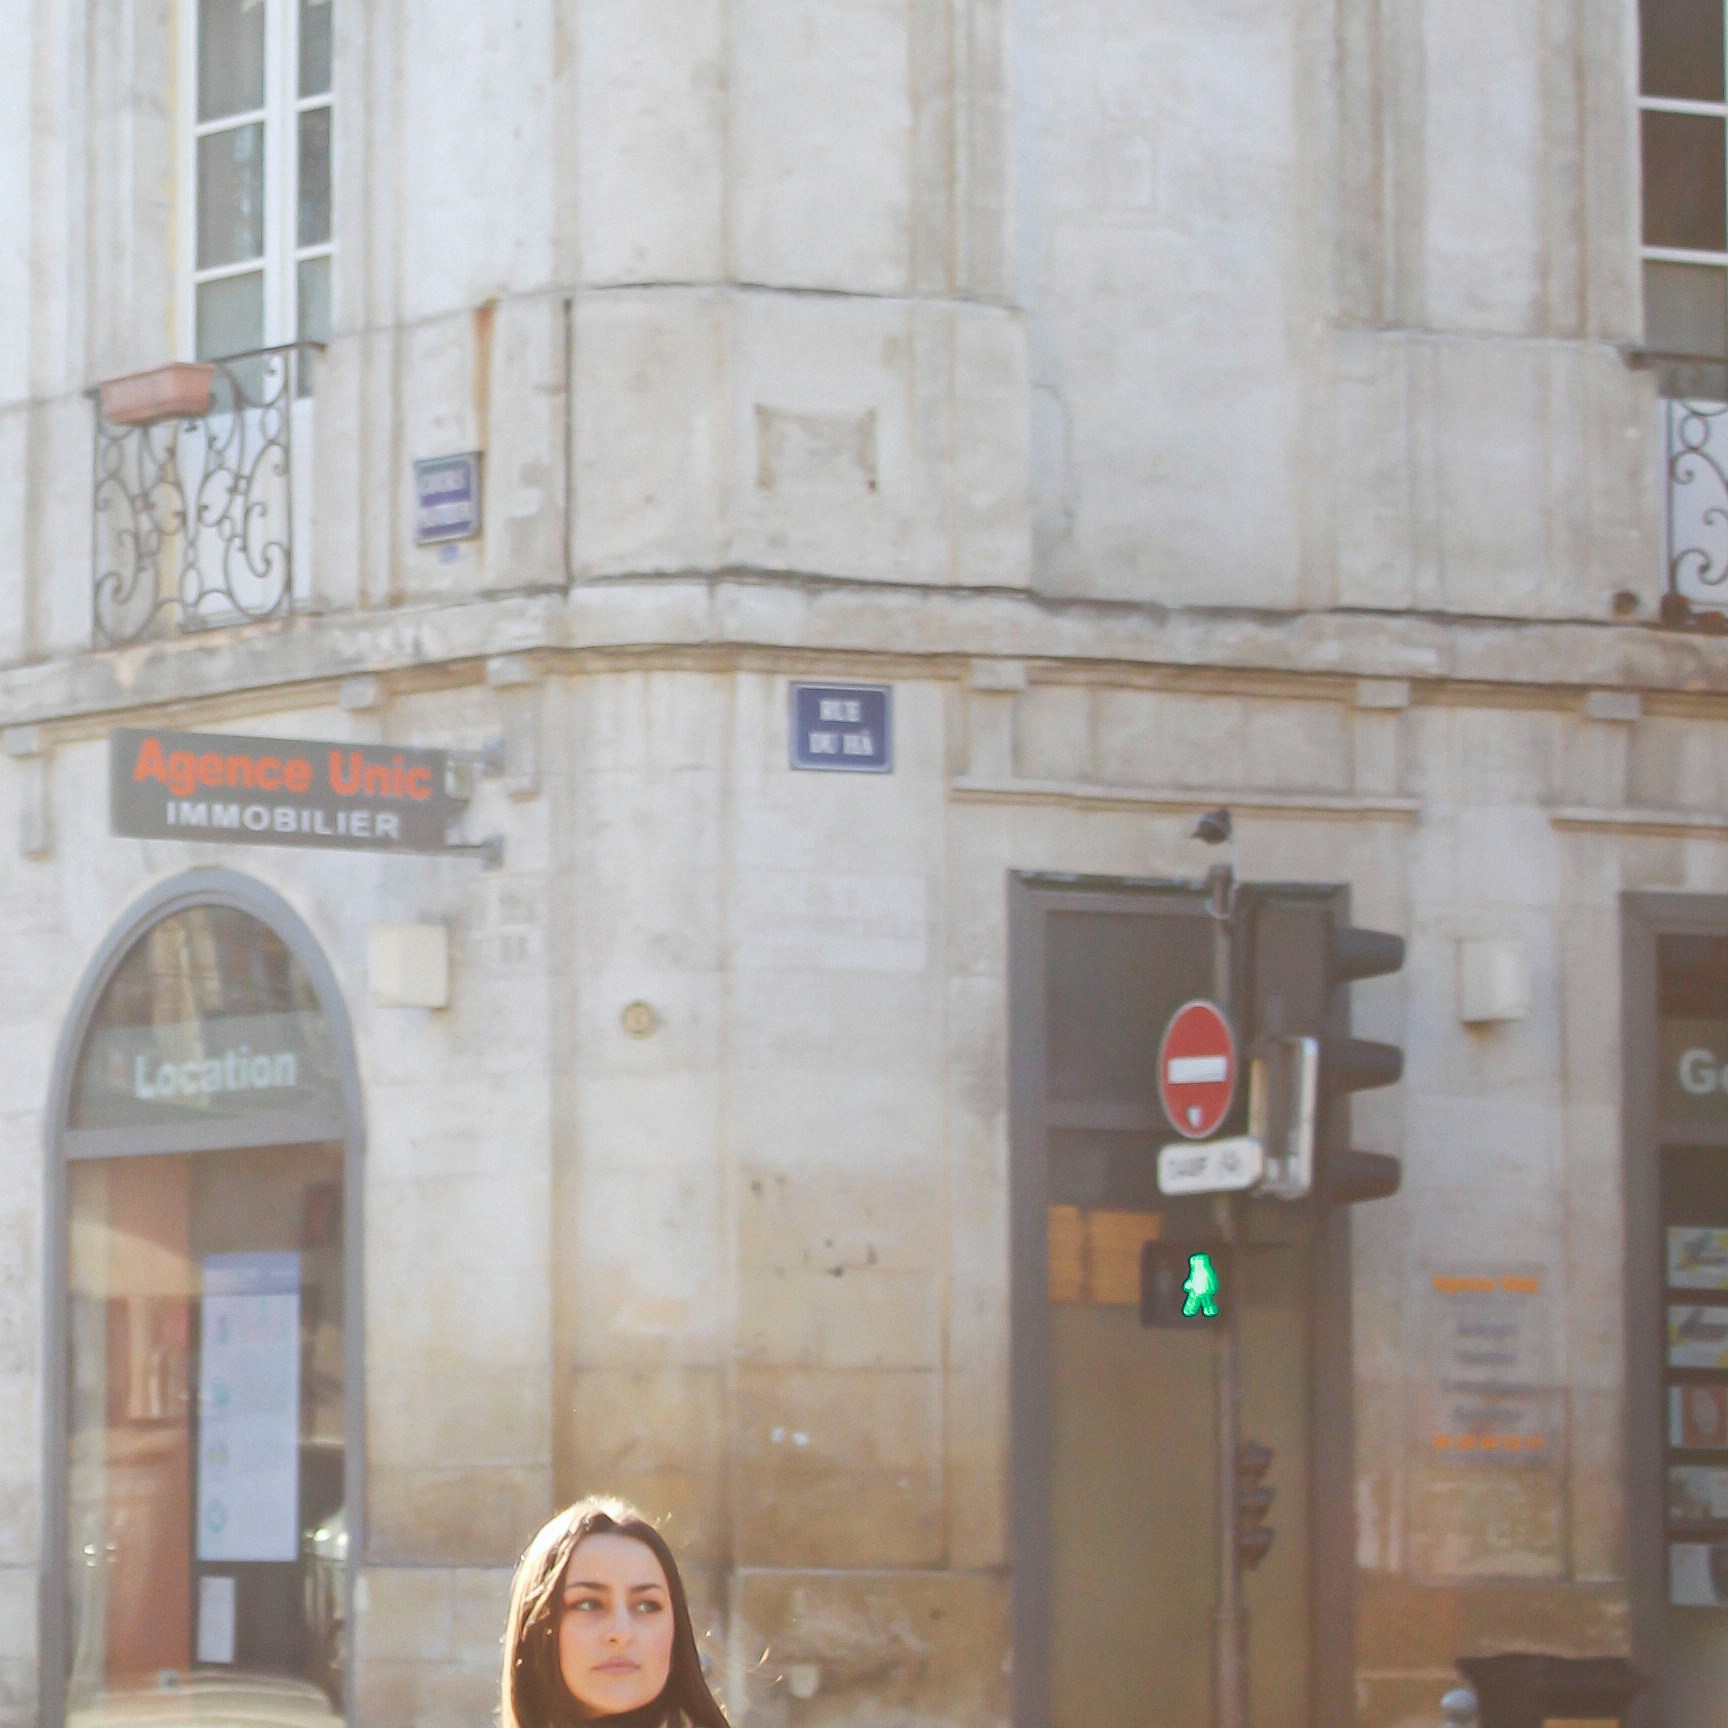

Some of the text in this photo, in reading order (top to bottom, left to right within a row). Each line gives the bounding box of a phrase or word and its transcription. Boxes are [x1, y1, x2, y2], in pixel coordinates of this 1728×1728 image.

[817, 698, 862, 723] RUE
[132, 737, 433, 801] Agence Unic
[165, 800, 401, 841] IMMOBILIER
[133, 1044, 299, 1101] Location
